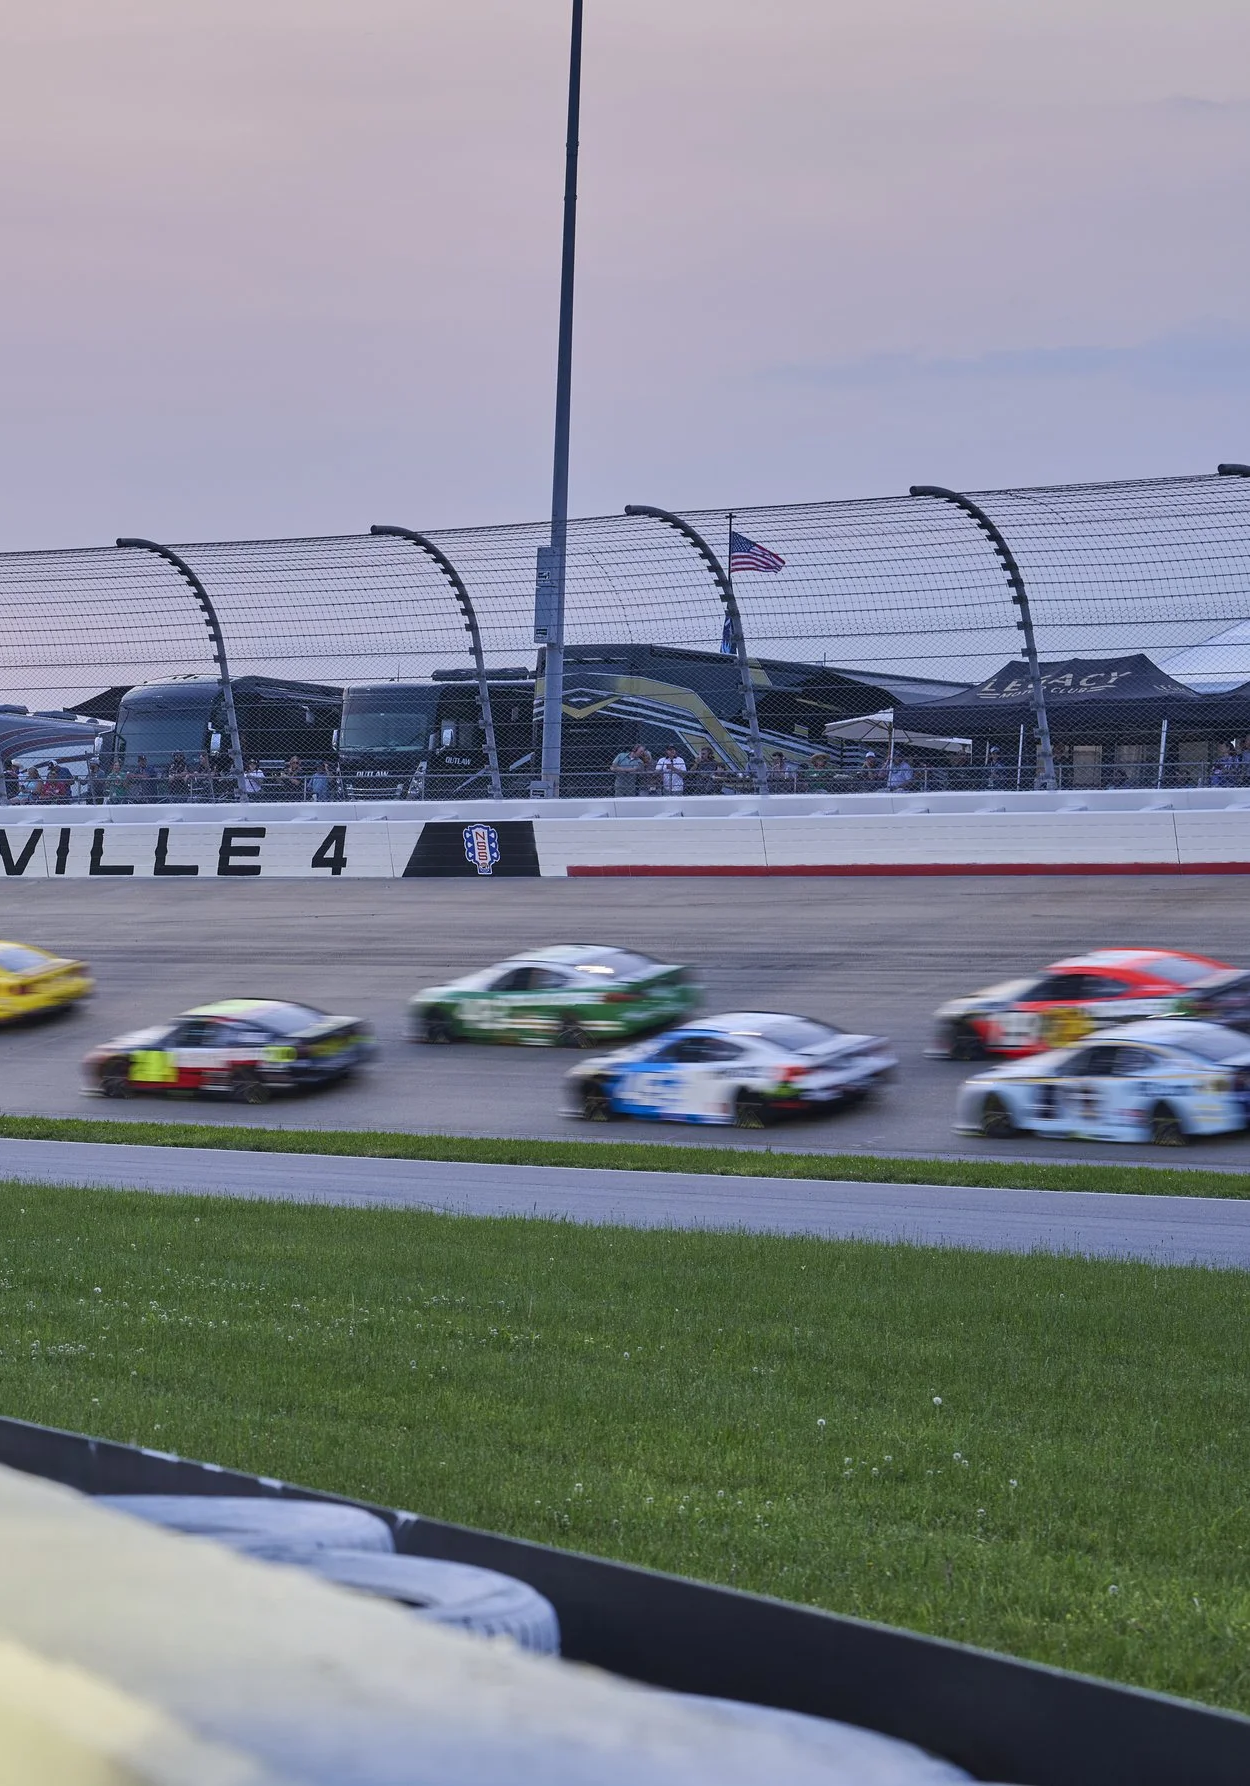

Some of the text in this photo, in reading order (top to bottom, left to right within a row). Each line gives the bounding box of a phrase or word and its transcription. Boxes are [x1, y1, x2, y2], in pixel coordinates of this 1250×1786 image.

[445, 757, 471, 766] OUTLAW
[311, 825, 348, 876] 4
[475, 831, 488, 861] NSS
